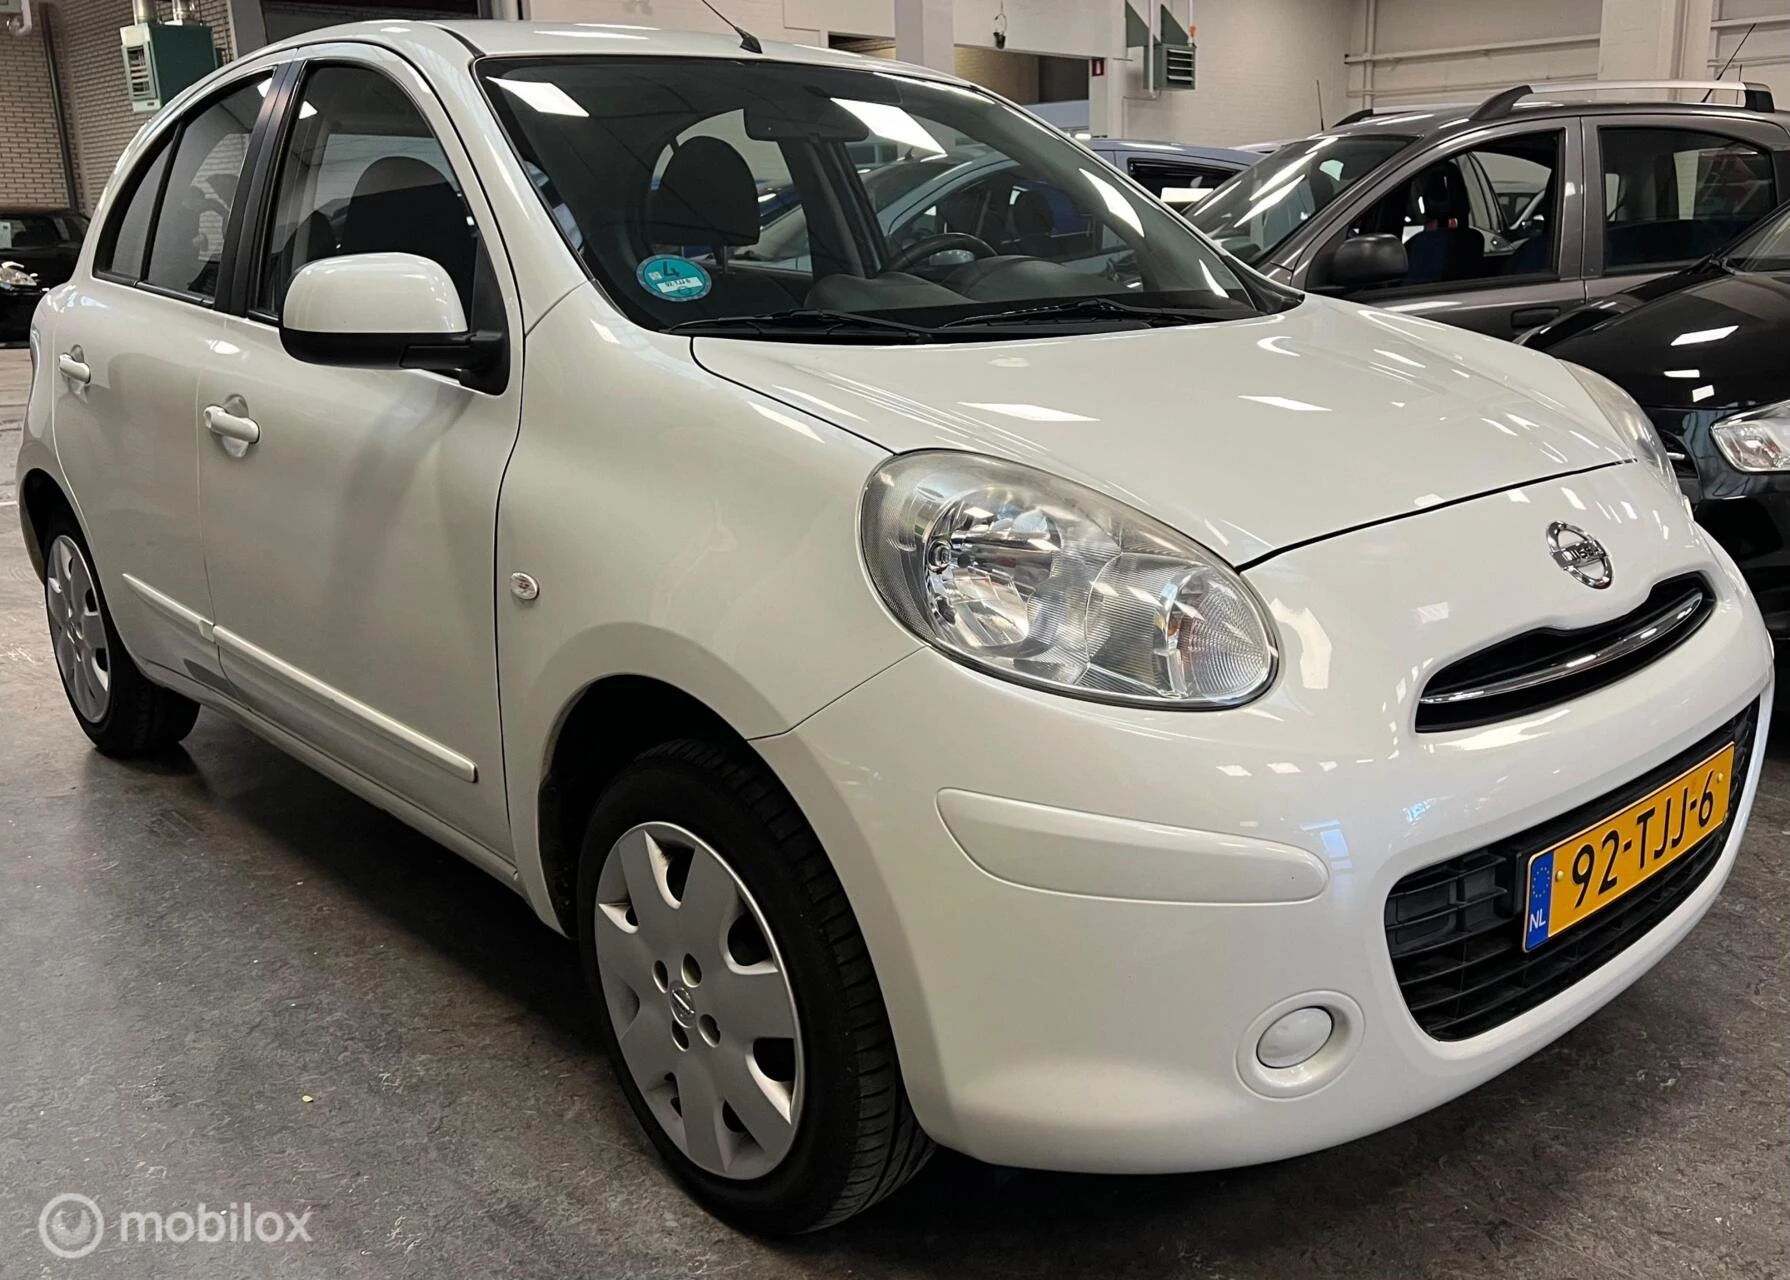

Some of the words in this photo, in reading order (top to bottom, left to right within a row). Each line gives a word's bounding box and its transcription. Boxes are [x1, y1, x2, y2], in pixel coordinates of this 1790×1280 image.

[663, 261, 680, 277] 4
[1571, 770, 1714, 909] 92-TJJ-6
[1529, 908, 1546, 932] NL
